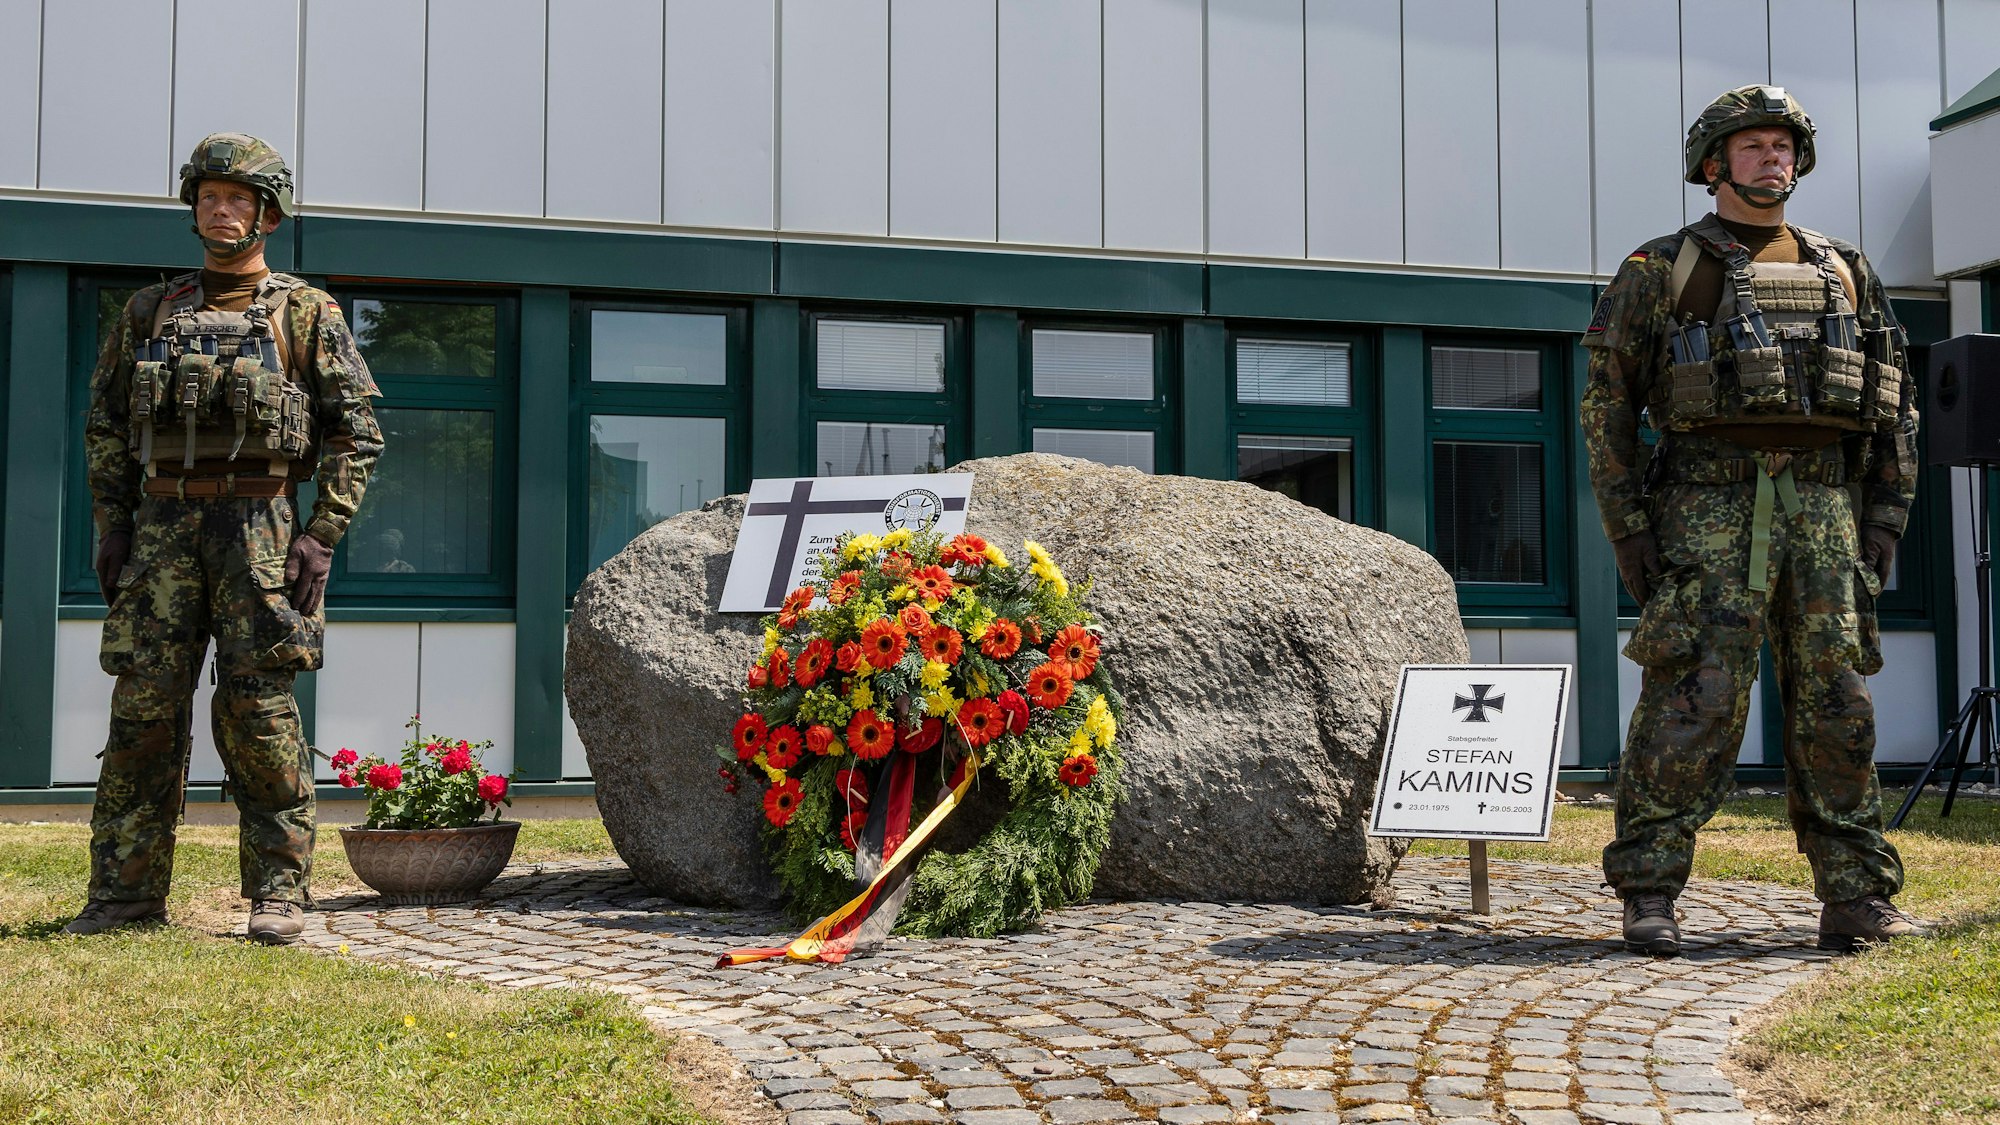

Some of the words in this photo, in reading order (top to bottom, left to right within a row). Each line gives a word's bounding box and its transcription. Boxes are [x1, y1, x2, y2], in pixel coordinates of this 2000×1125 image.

[205, 325, 239, 333] FISCHER
[809, 535, 833, 544] Zum
[806, 547, 820, 555] an
[822, 546, 837, 555] di
[801, 567, 820, 576] der
[1447, 735, 1499, 744] Stabsgefreiter
[1426, 749, 1513, 764] STEFAN
[1398, 769, 1534, 795] KAMINS
[1408, 803, 1451, 812] 23.01.1975
[1489, 805, 1533, 814] 29.05.2003
